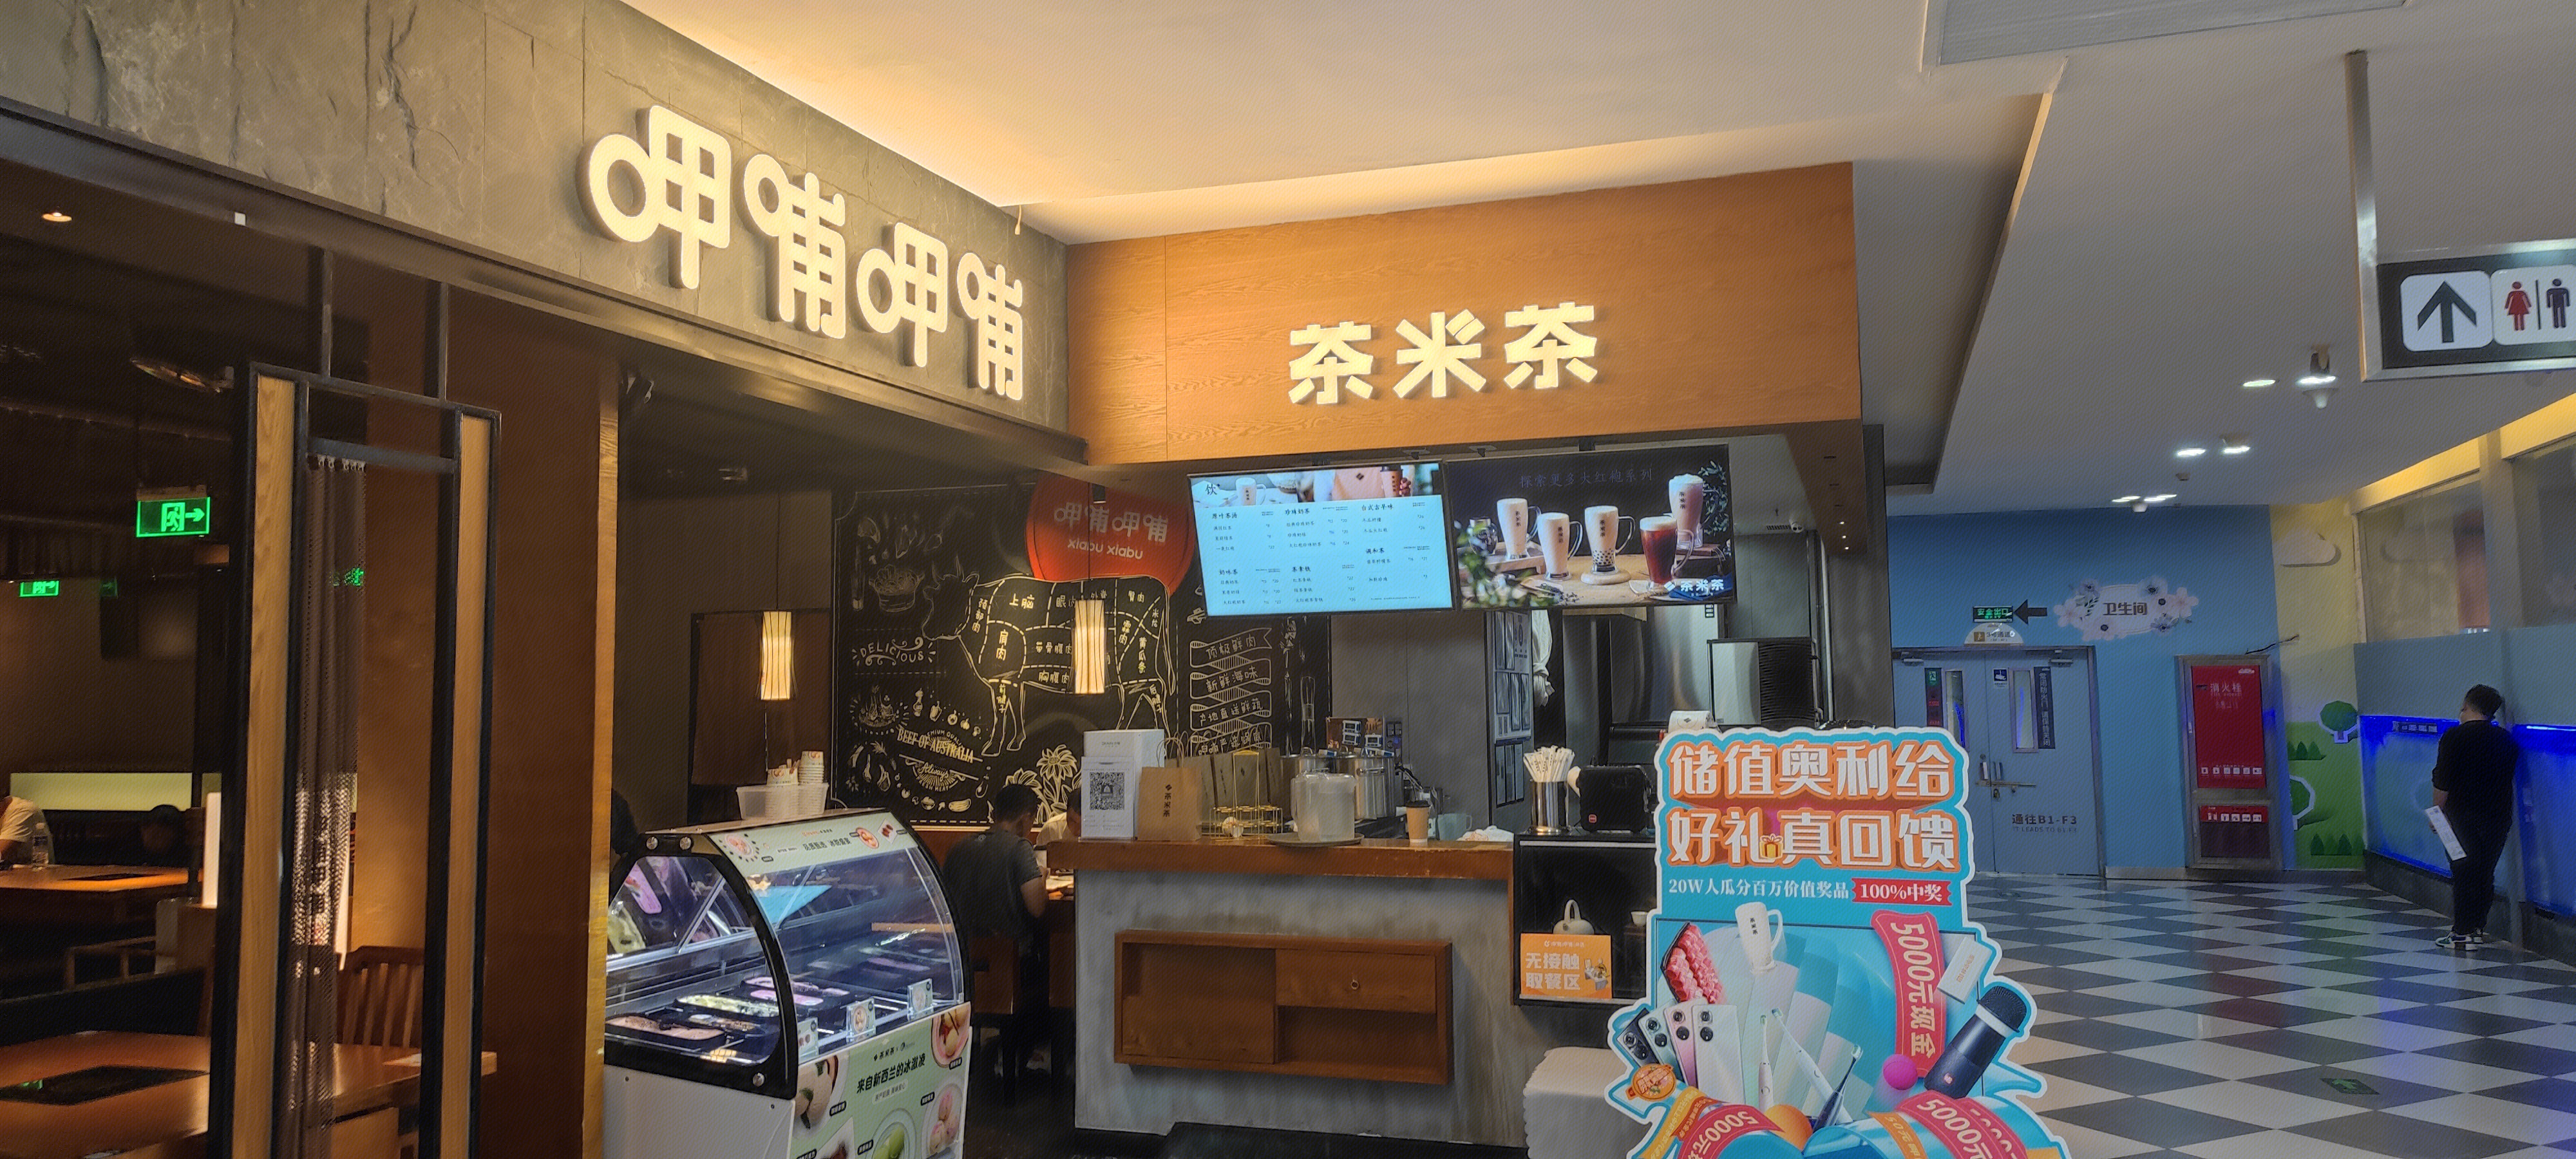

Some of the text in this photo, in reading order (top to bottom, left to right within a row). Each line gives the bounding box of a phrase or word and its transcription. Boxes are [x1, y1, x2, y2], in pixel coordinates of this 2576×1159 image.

[589, 106, 1023, 400] 呷哺呷哺
[1289, 301, 1598, 404] 茶米茶
[1520, 467, 1653, 488] 探索更多大红袍系列
[1361, 503, 1394, 511] 台式古早味
[1054, 501, 1169, 543] 呷哺呷哺
[1067, 538, 1144, 560] xiabu xiabu
[1681, 579, 1724, 592] 茶米茶
[1009, 593, 1036, 609] 上脑
[2103, 601, 2148, 616] 卫生间
[860, 641, 924, 663] DELICIOUS
[996, 629, 1009, 661] 肩肉
[1137, 637, 1148, 674] 黄瓜条
[1206, 634, 1256, 660] 顶极鲜肉
[1038, 670, 1070, 684] 胸腹肉
[1206, 665, 1259, 693] 新鲜海味
[2210, 683, 2242, 693] 消火栓
[1199, 697, 1263, 726] 产地直送鲜蔬
[896, 728, 973, 764] BEEF OF AUSTRALIA
[1669, 742, 1949, 798] 储值奥利给
[1163, 793, 1171, 817] 茶米茶
[2012, 814, 2077, 825] 通往B1-F3
[1669, 811, 1955, 869] 好礼真回馈
[1669, 878, 1943, 903] 20W人瓜分百万价值奖品 100%中奖
[1526, 952, 1580, 970] 无接触
[1526, 972, 1580, 990] 取餐区
[1890, 922, 1937, 1058] 5000元现金
[857, 1052, 926, 1094] 来自新西兰的冰激凌
